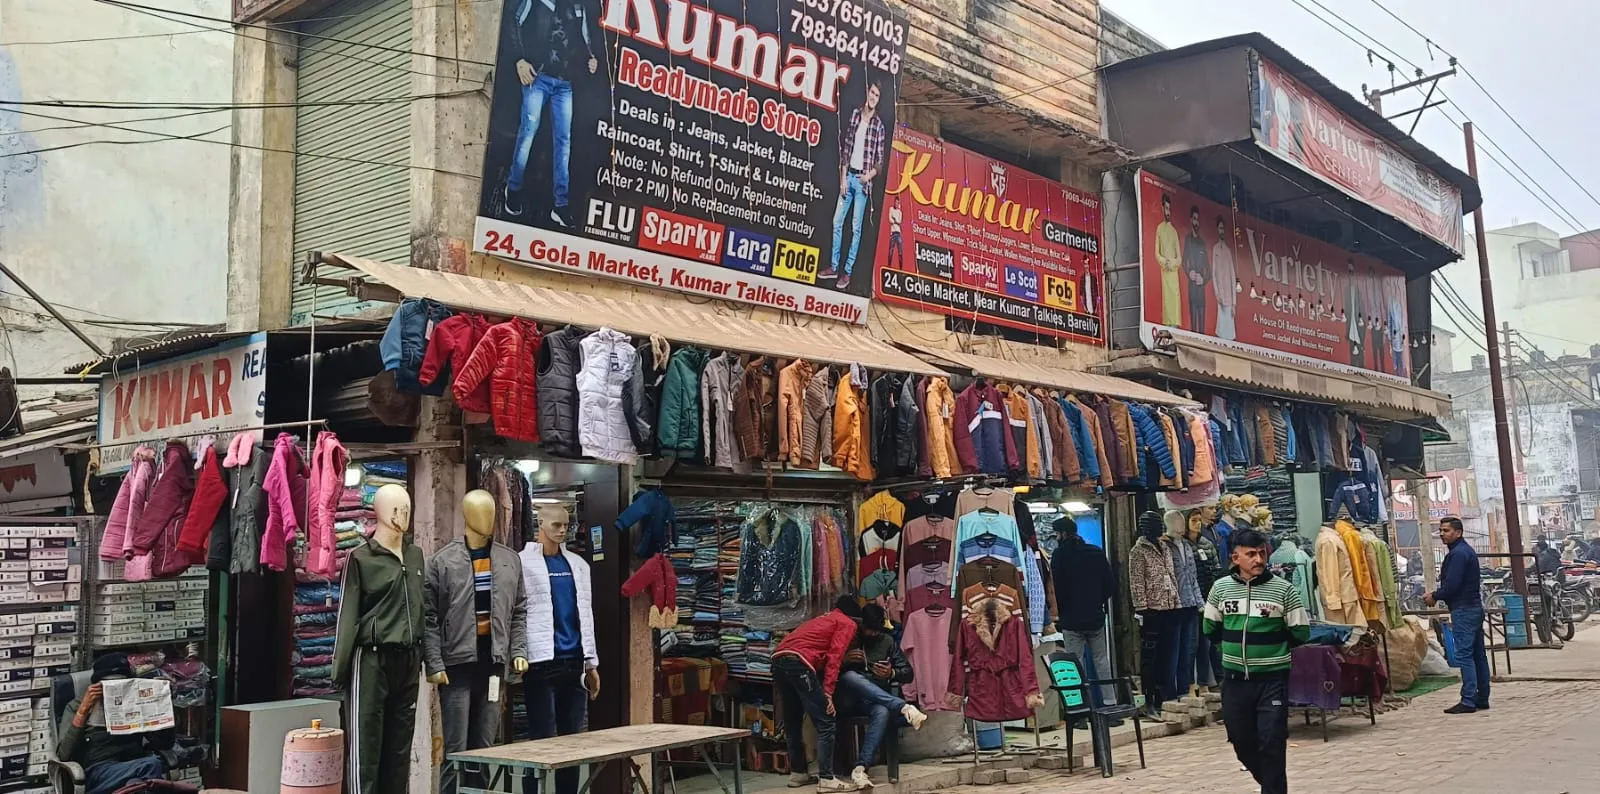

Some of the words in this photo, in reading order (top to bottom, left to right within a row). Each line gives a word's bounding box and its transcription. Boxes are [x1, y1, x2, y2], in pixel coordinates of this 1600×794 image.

[798, 0, 903, 46] 37651003
[791, 9, 901, 74] 7983641426
[618, 47, 759, 125] Readymade
[762, 98, 821, 146] Store
[619, 99, 659, 124] Deals
[663, 113, 676, 131] in
[687, 122, 728, 149] Jeans,
[732, 136, 776, 163] Jacket,
[779, 150, 814, 172] Blazer
[1303, 97, 1375, 182] Variety
[597, 120, 664, 156] Raincoat,
[669, 142, 704, 168] Shirt,
[709, 153, 751, 178] T-Shirt
[753, 167, 761, 181] &
[765, 170, 800, 192] Lower
[803, 181, 823, 200] Etc.
[614, 149, 648, 172] Note:
[651, 160, 668, 177] No
[671, 165, 713, 189] Refund
[715, 178, 740, 200] Only
[742, 186, 807, 215] Replacement
[885, 141, 1041, 235] Kumar
[587, 198, 636, 233] FLU
[597, 167, 634, 189] (After
[635, 178, 643, 193] 2
[646, 180, 669, 202] PM)
[673, 187, 688, 204] No
[692, 192, 760, 222] Replacement
[763, 214, 776, 227] on
[778, 215, 815, 239] Sunday
[607, 231, 619, 240] LIKE
[620, 233, 631, 242] YOU
[644, 211, 722, 256] Sparky
[727, 231, 771, 265] Lara
[1045, 223, 1098, 253] Garments
[699, 253, 716, 262] JEANS
[750, 264, 766, 273] JEANS
[775, 242, 815, 274] Fode
[915, 242, 954, 268] Leespark
[962, 256, 998, 281] Sparky
[1246, 227, 1338, 310] Variety
[484, 230, 520, 259] 24,
[530, 240, 579, 267] Gola
[587, 251, 663, 287] Market,
[670, 267, 732, 296] Kumar
[737, 281, 798, 312] Talkies,
[804, 295, 862, 325] Bareilly
[796, 274, 810, 282] JEANS
[1004, 266, 1016, 285] Le
[1018, 270, 1038, 290] Scot
[1048, 277, 1073, 300] Fob
[884, 271, 901, 293] 24,
[904, 276, 931, 297] Gole
[933, 282, 971, 308] Market,
[974, 291, 998, 311] Near
[1000, 297, 1030, 318] Kumar
[1032, 305, 1066, 328] Talkies,
[1068, 313, 1099, 335] Bareilly
[1271, 292, 1321, 322] CENTER
[1253, 312, 1259, 322] A
[1260, 315, 1277, 328] House
[1277, 320, 1285, 330] Of
[113, 357, 233, 440] KUMAR
[1224, 600, 1239, 614] 53
